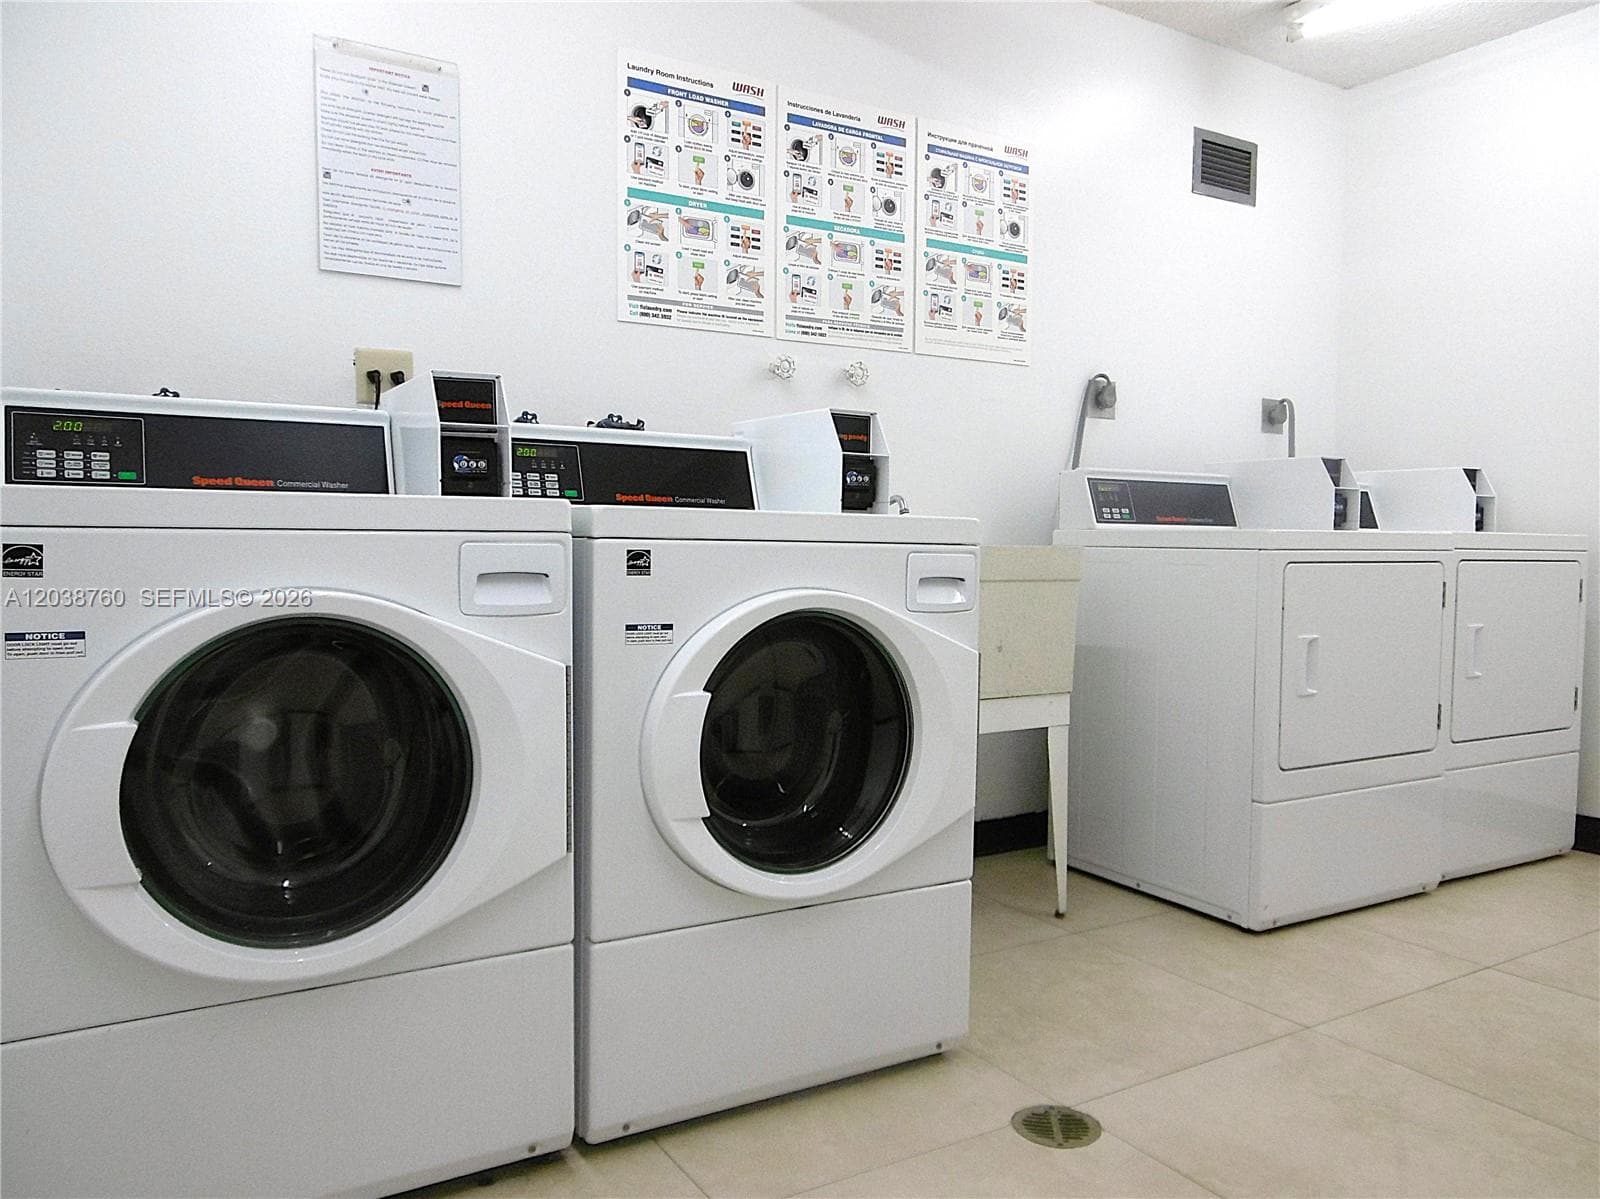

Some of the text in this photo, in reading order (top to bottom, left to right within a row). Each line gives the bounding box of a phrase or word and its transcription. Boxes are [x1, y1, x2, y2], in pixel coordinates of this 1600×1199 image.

[627, 62, 714, 88] Laundry Room Instructions
[732, 82, 764, 97] WASH
[668, 88, 729, 107] FRONT LOAD WASHER
[787, 100, 823, 114] Instrucciones
[877, 115, 906, 129] WASH
[1004, 146, 1029, 158] WASH
[465, 401, 492, 409] Queen
[192, 476, 232, 486] Speed
[235, 477, 274, 486] Queen
[322, 480, 349, 488] Washer
[616, 493, 644, 502] Speed
[645, 494, 672, 502] Queen
